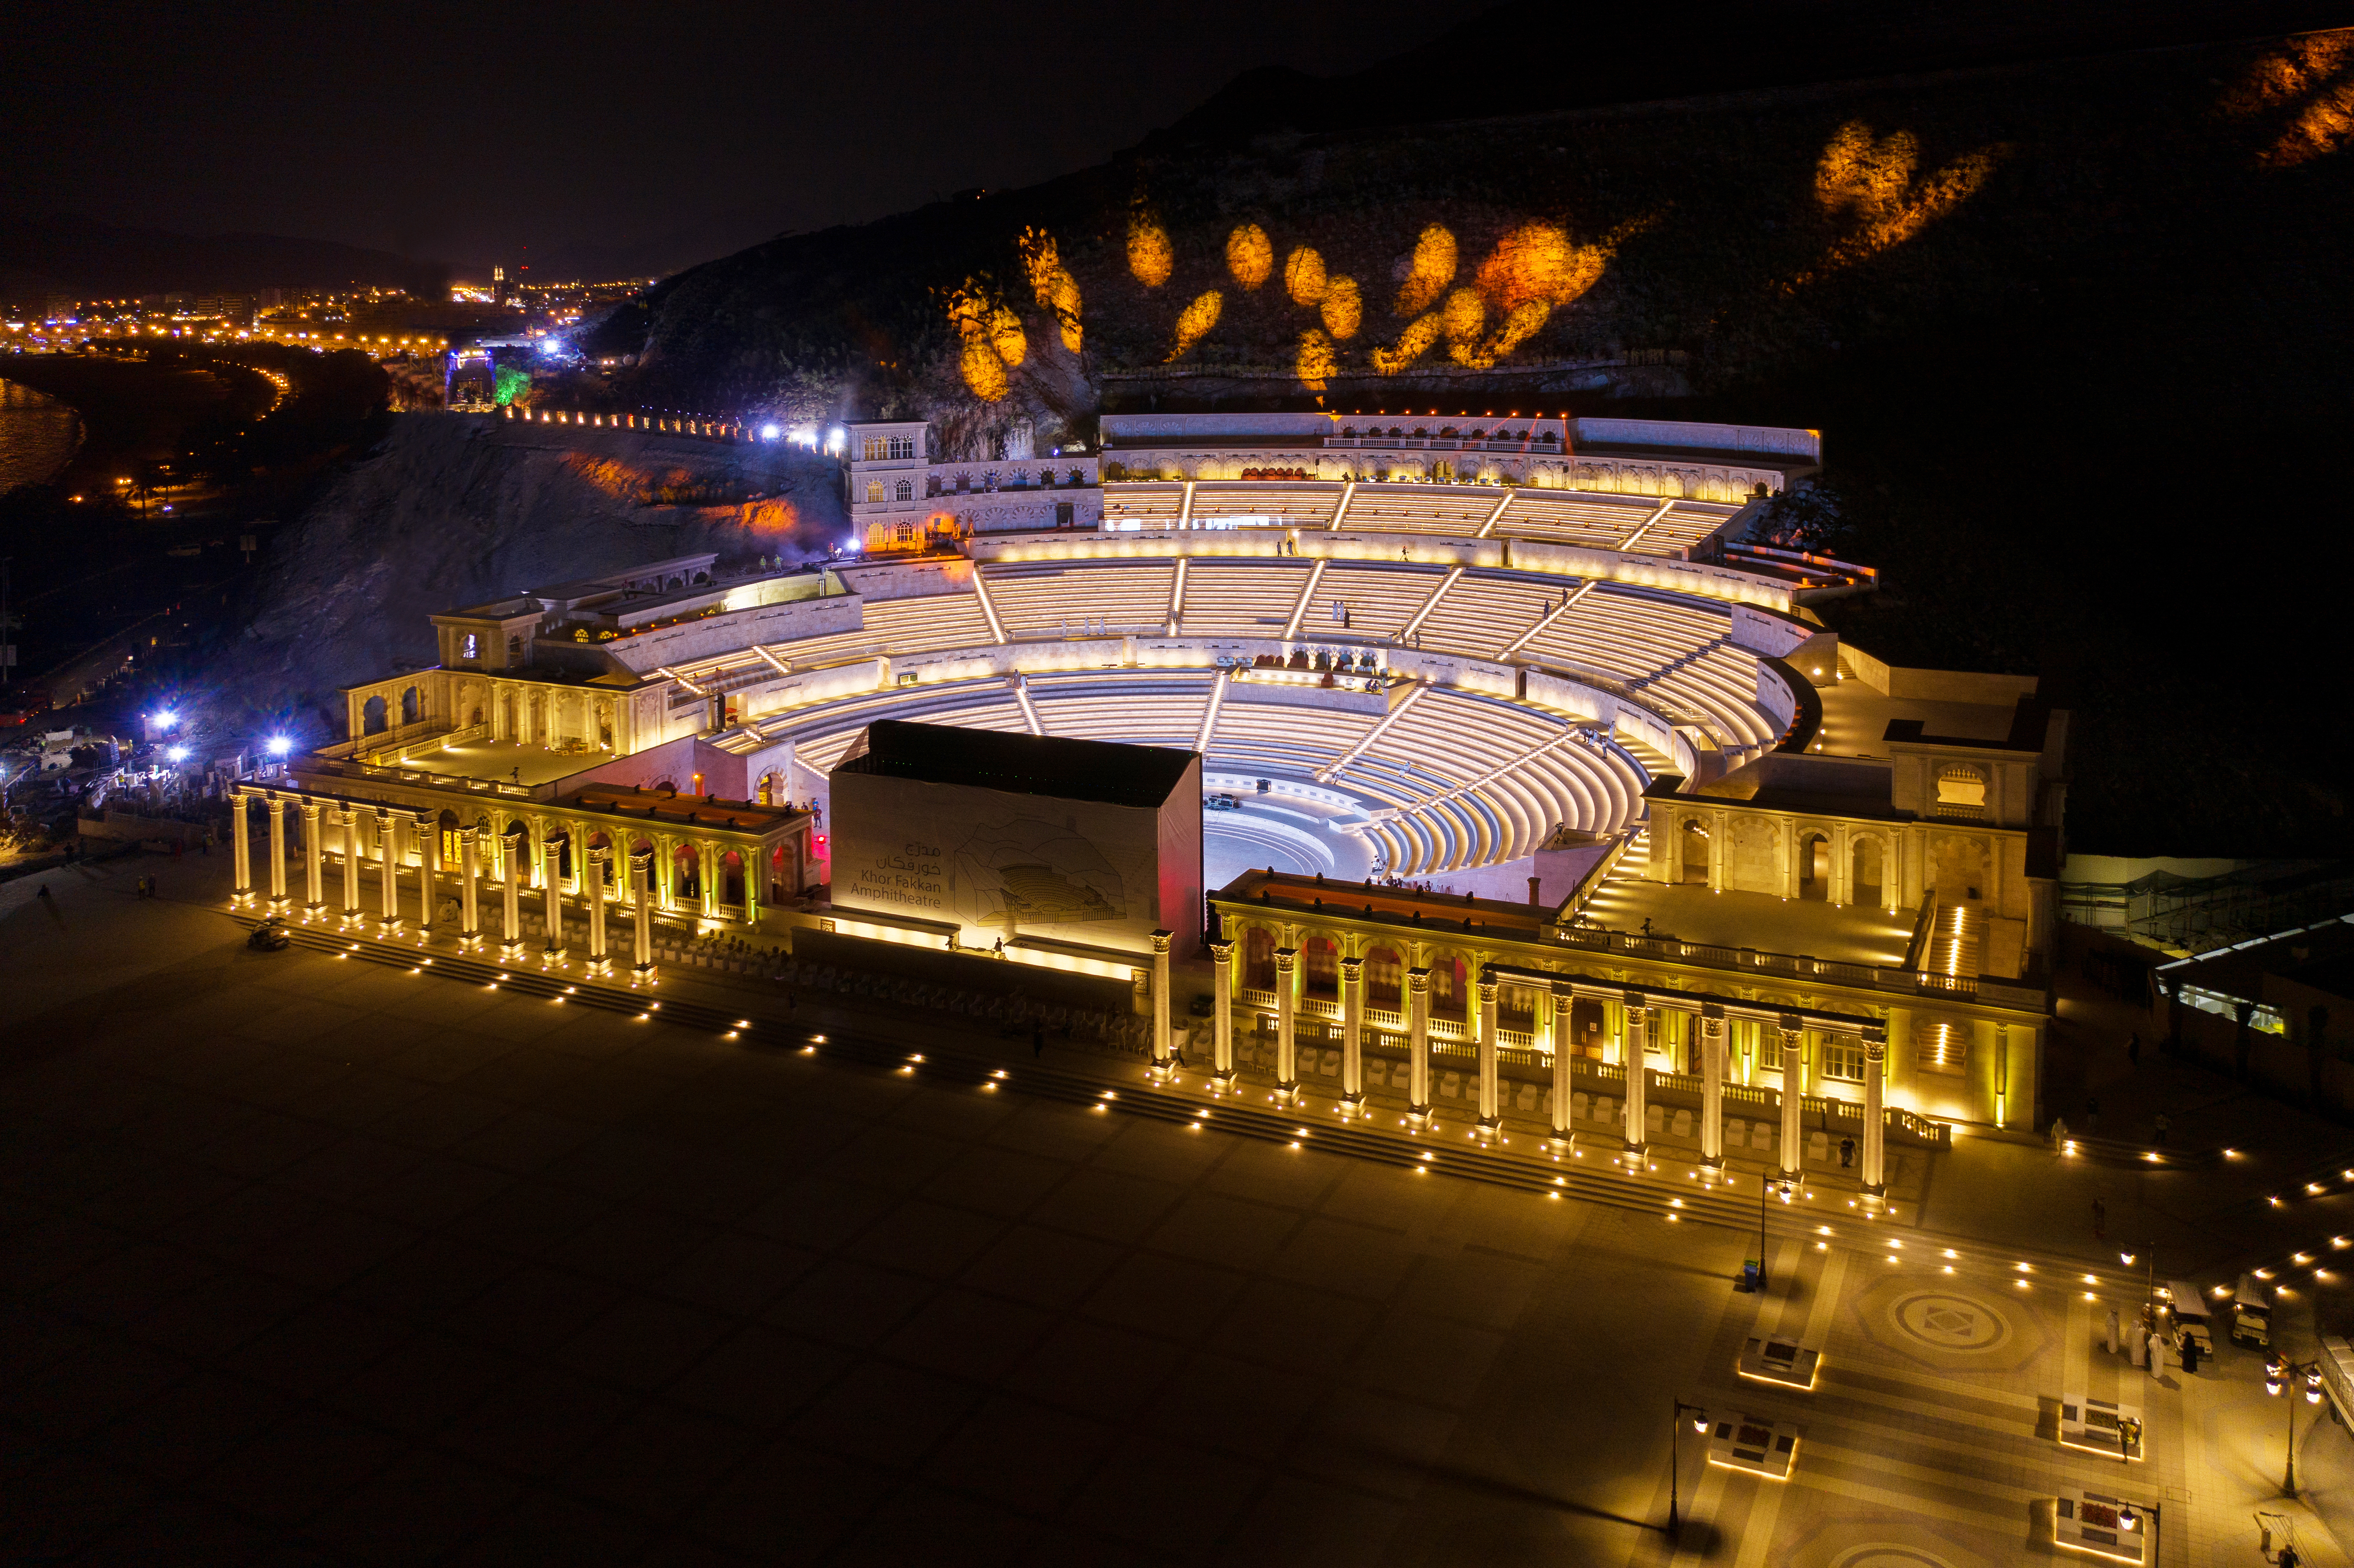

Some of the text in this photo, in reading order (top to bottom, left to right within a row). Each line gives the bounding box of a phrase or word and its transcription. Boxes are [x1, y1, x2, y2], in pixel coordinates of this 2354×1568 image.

[862, 869, 940, 893] Khor Fakkan
[851, 883, 940, 908] Amphitheatre
